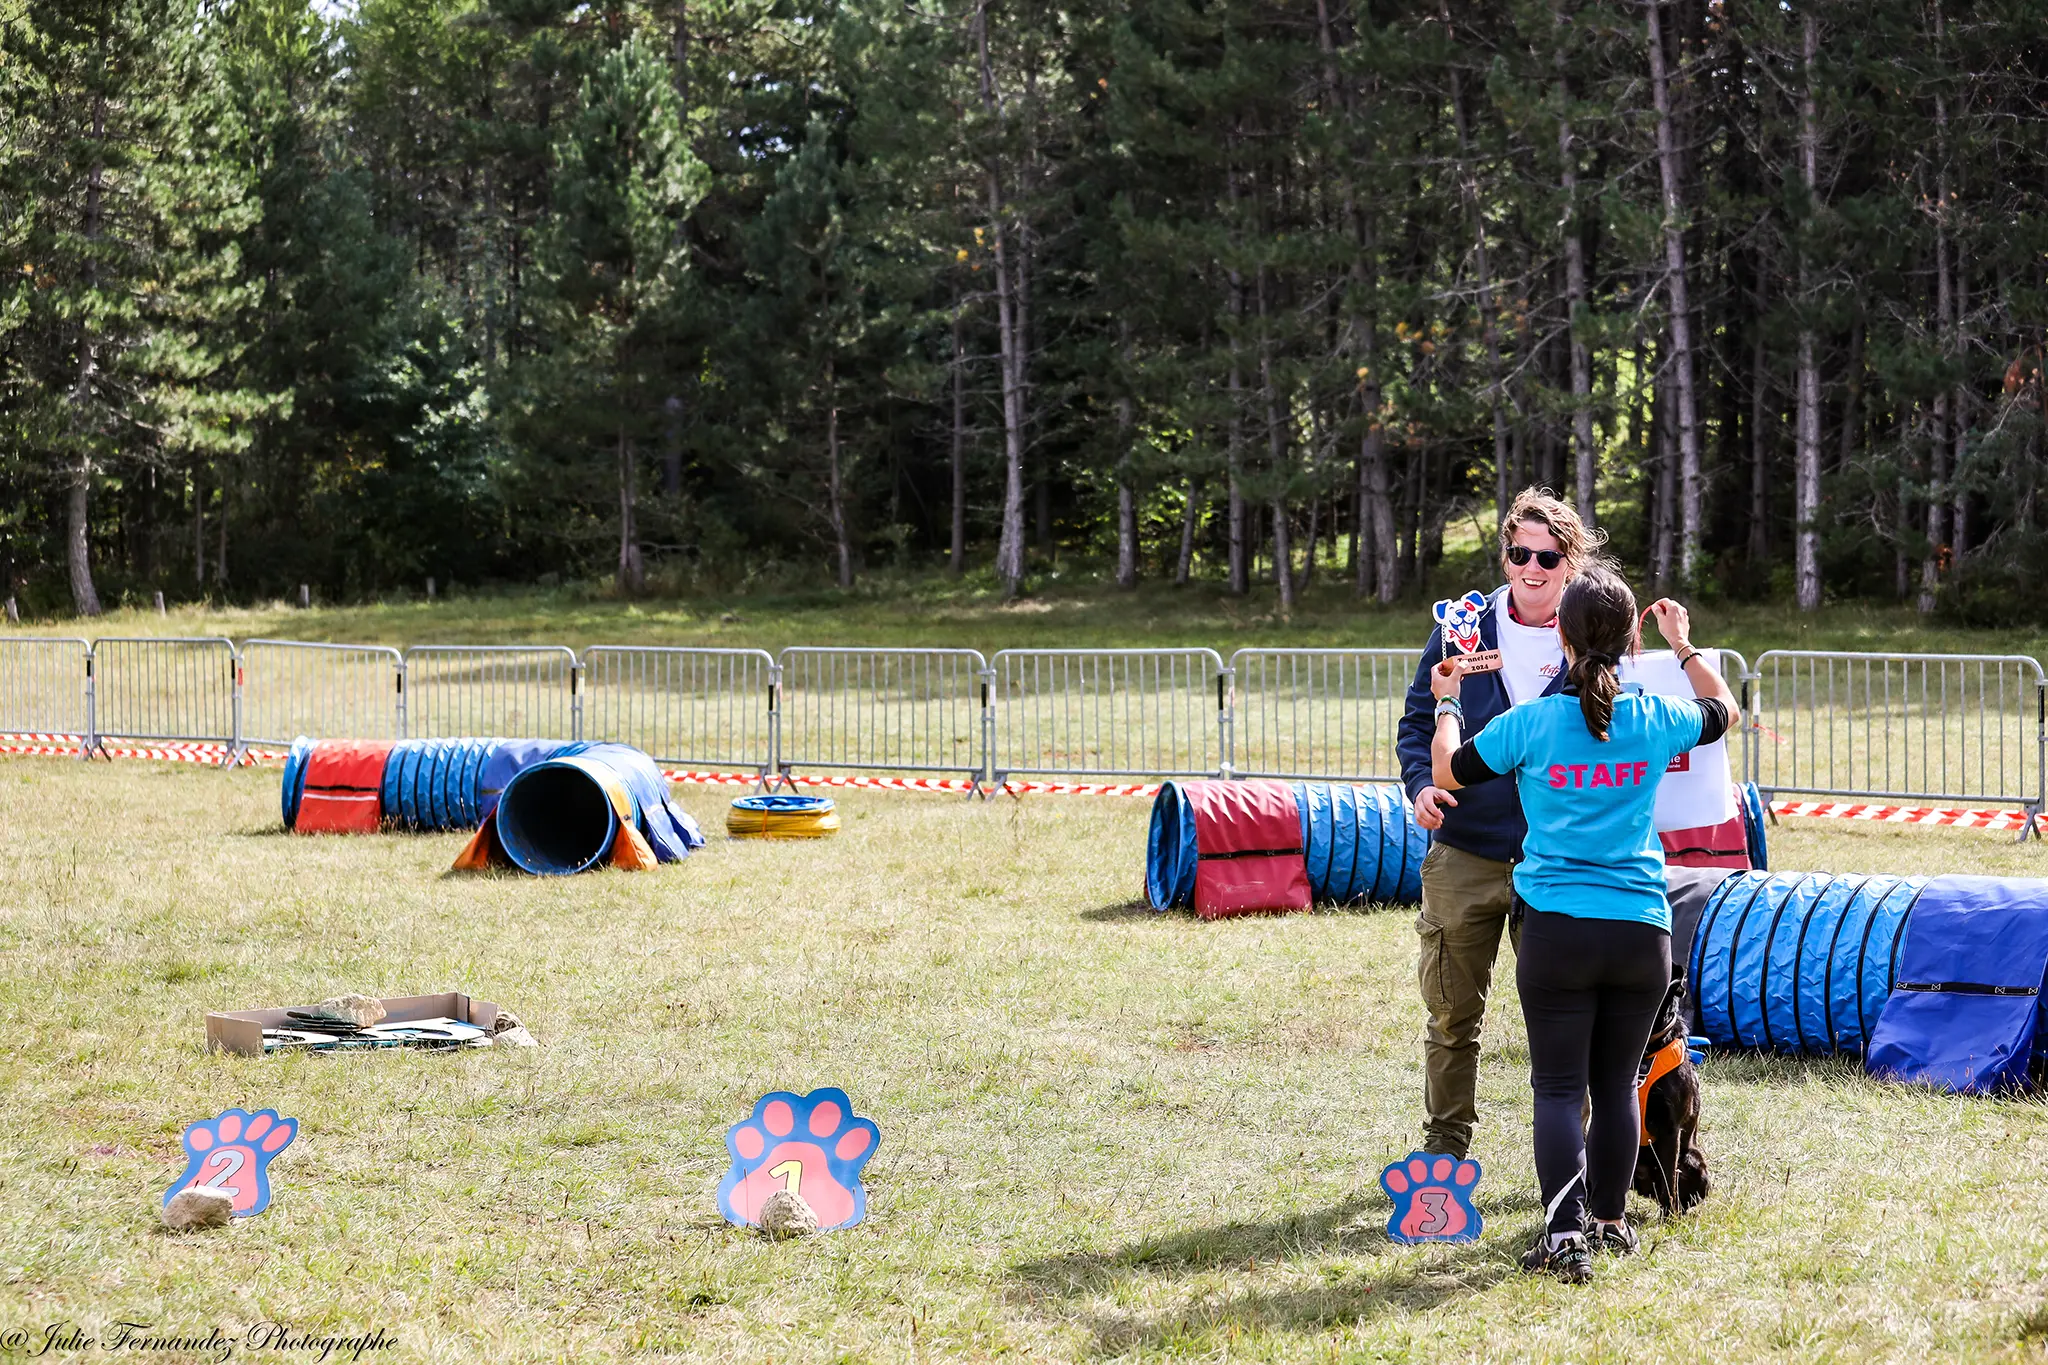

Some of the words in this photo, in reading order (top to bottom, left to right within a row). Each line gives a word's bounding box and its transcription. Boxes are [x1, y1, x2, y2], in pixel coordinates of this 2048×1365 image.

[1457, 655, 1484, 663] Tnnel
[1471, 663, 1489, 671] 2024
[1548, 761, 1648, 788] STAFF
[204, 1149, 245, 1197] 2
[768, 1160, 803, 1195] 1
[1419, 1193, 1449, 1234] 3
